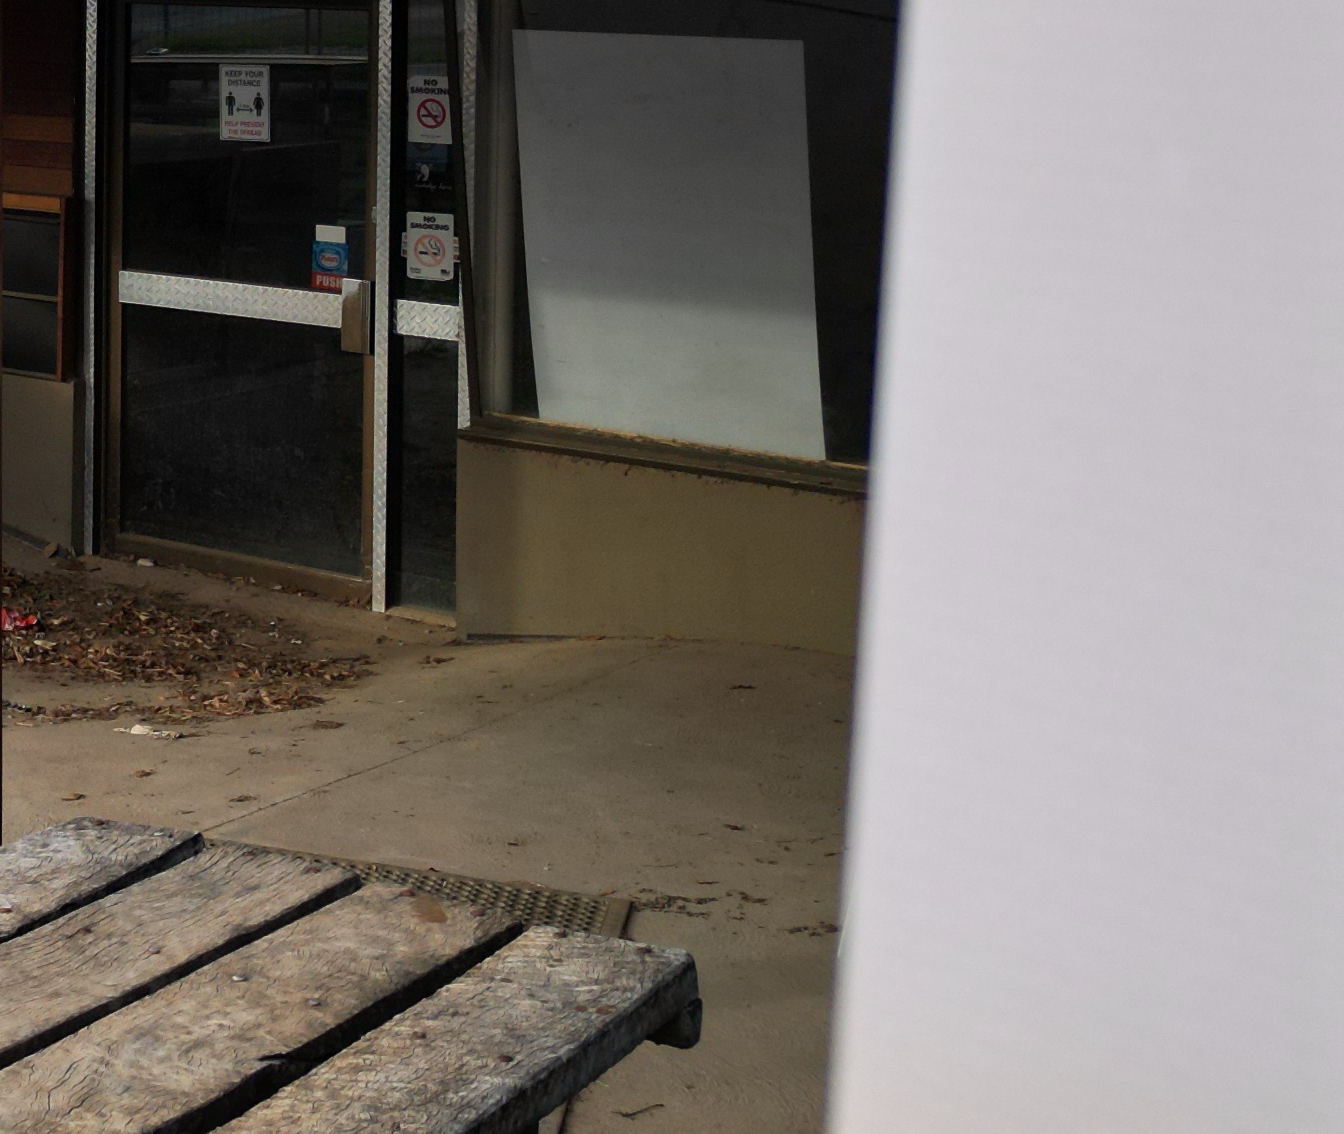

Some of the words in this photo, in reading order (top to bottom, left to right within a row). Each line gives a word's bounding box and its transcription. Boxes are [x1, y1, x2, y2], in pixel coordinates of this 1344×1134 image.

[224, 69, 243, 78] KEEP
[244, 70, 264, 79] YOUR
[227, 78, 262, 87] DISTANCE
[423, 78, 438, 87] NO
[409, 86, 450, 95] SMOKIN
[422, 215, 437, 224] NO
[409, 222, 450, 232] SMOKING
